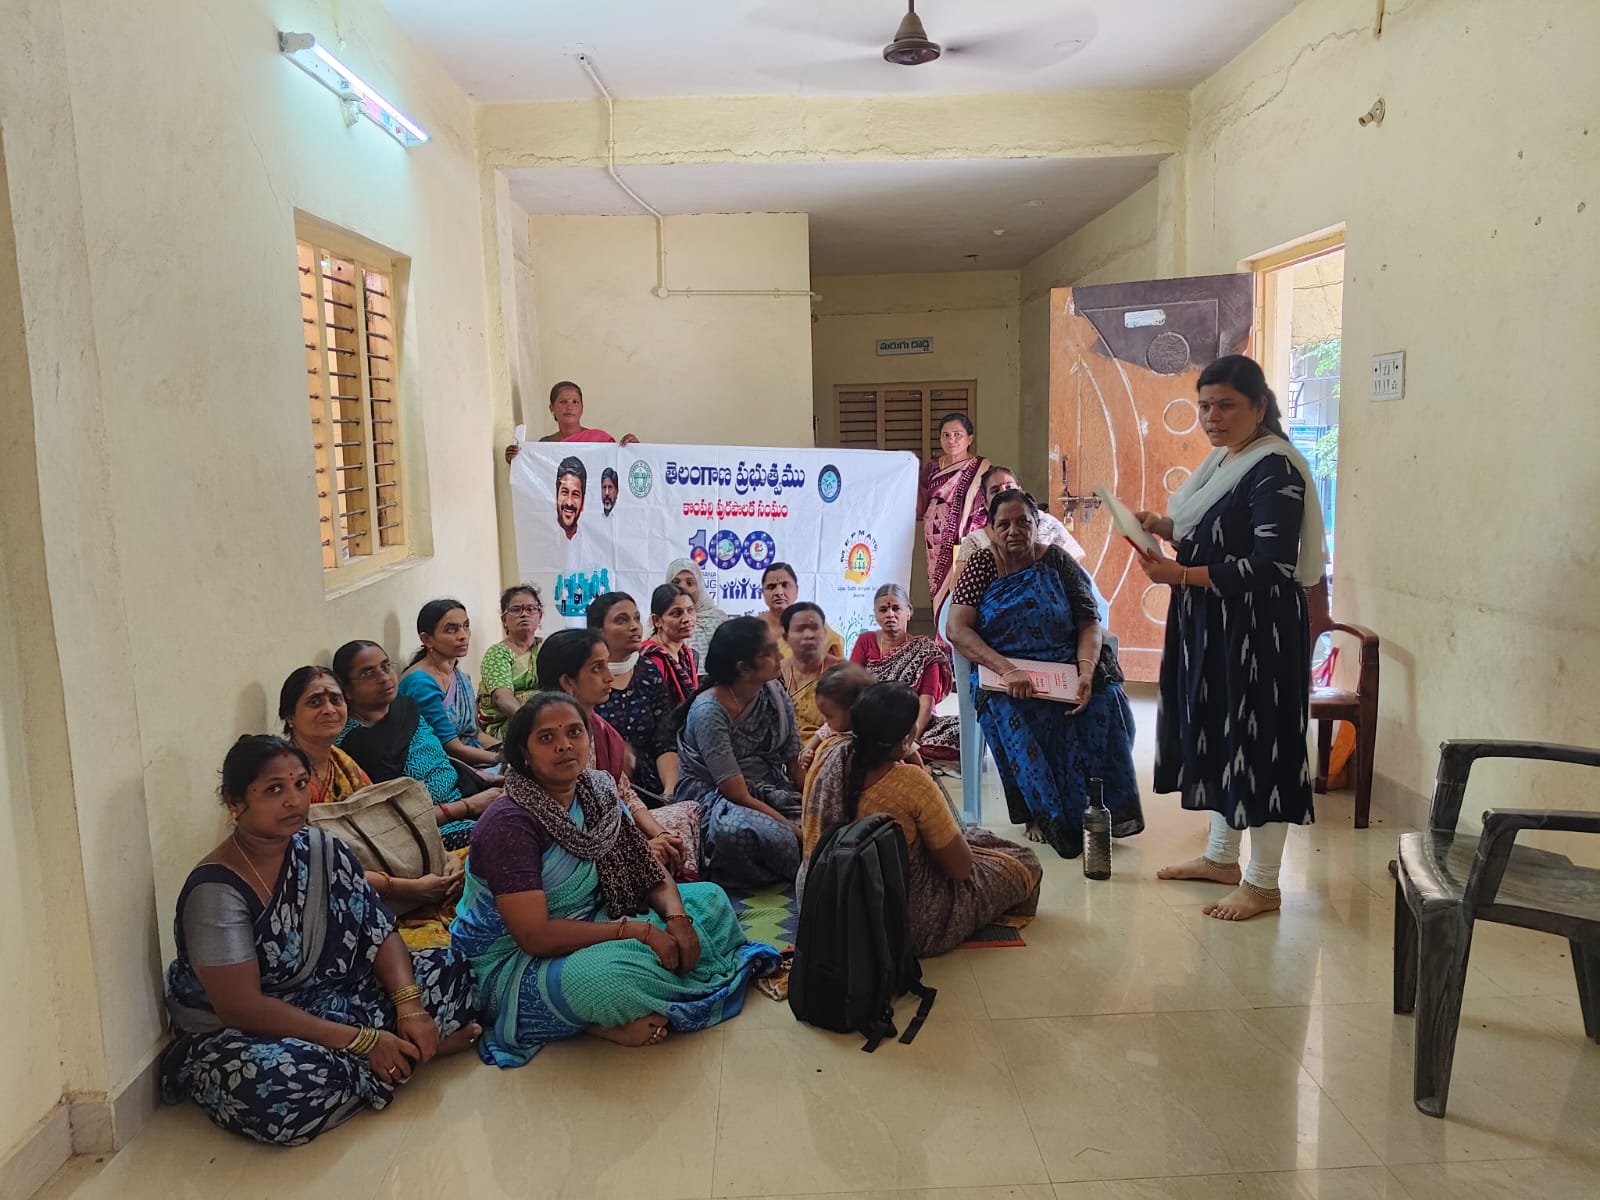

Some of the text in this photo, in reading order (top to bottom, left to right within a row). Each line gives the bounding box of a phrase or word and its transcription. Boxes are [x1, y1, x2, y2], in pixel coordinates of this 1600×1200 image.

[665, 461, 731, 486] తెలంగాణ
[735, 461, 805, 495] ప్రభుత్వము
[716, 499, 755, 520] పురపాలక
[758, 500, 788, 521] సంఘం
[689, 529, 776, 570] 100
